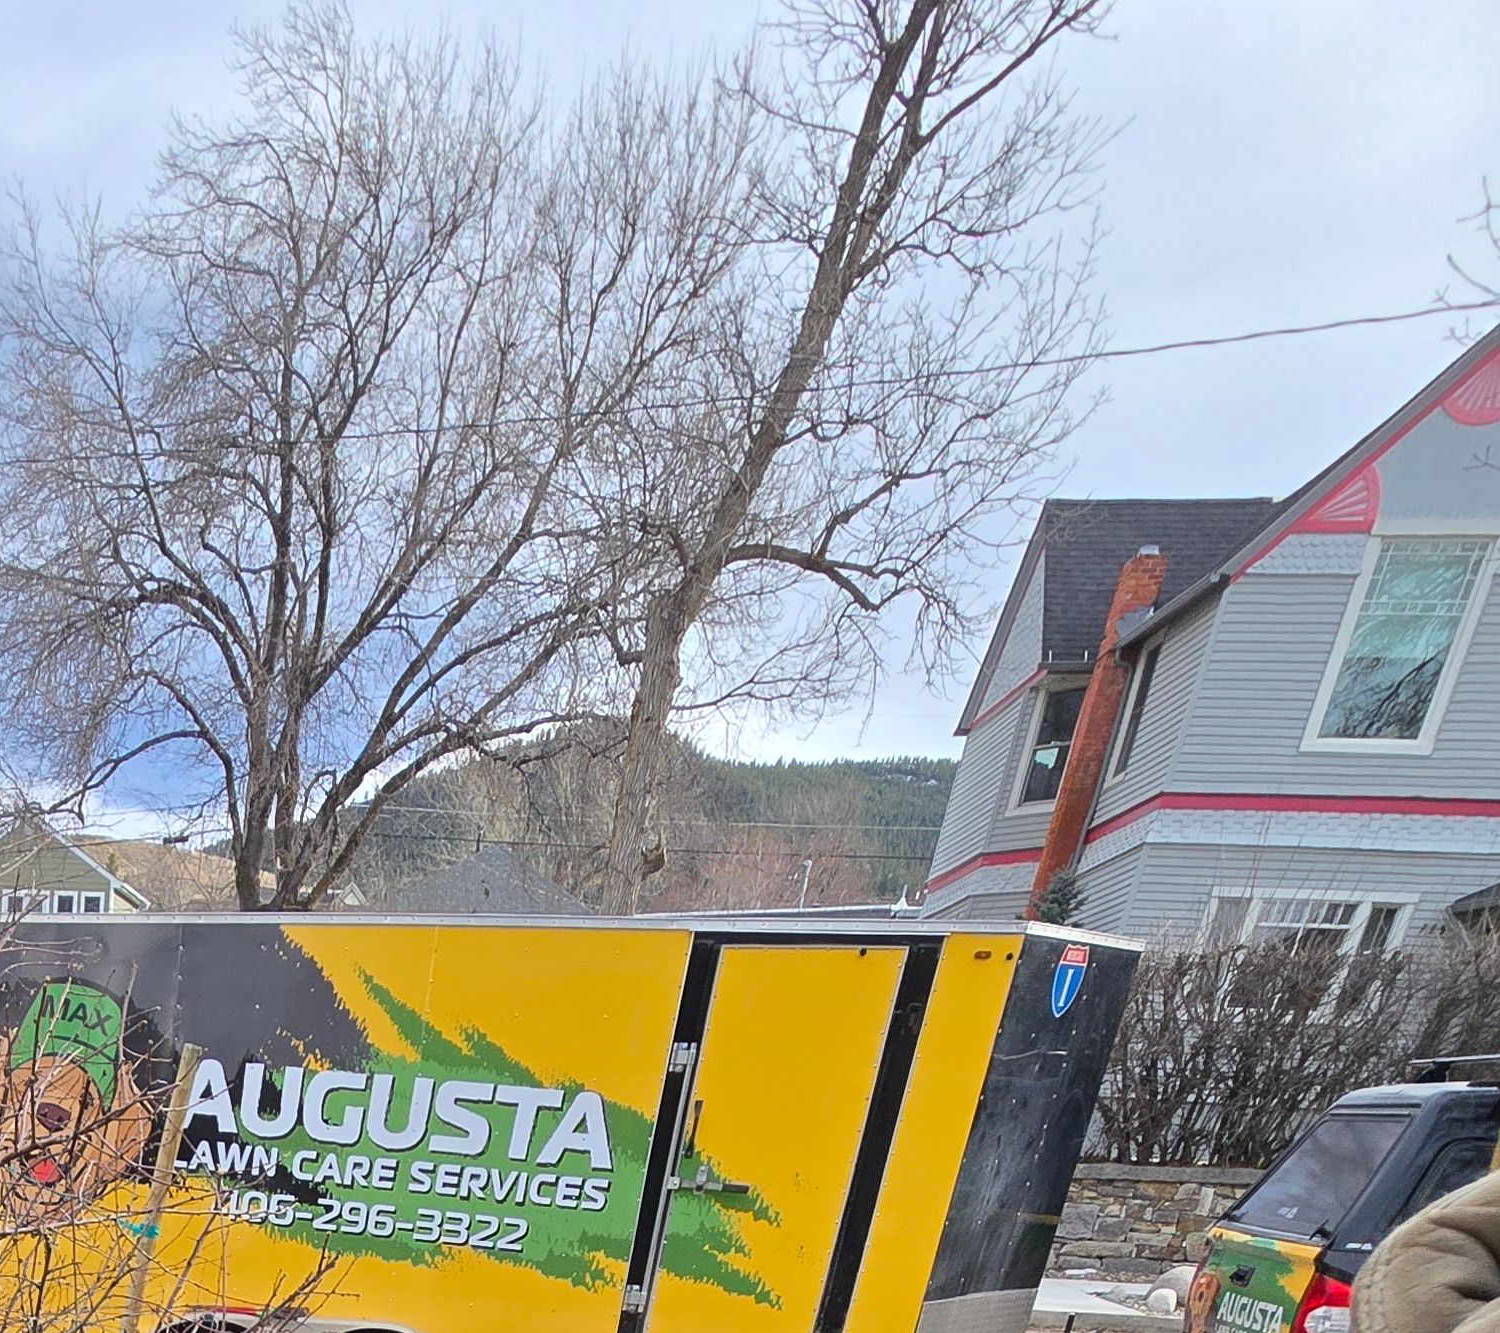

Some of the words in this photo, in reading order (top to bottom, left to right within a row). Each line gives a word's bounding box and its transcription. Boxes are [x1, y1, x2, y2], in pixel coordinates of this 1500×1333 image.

[41, 994, 113, 1037] MAX
[183, 1058, 613, 1171] AUGUSTA
[291, 1150, 398, 1189] CARE
[408, 1160, 611, 1211] SERVICES
